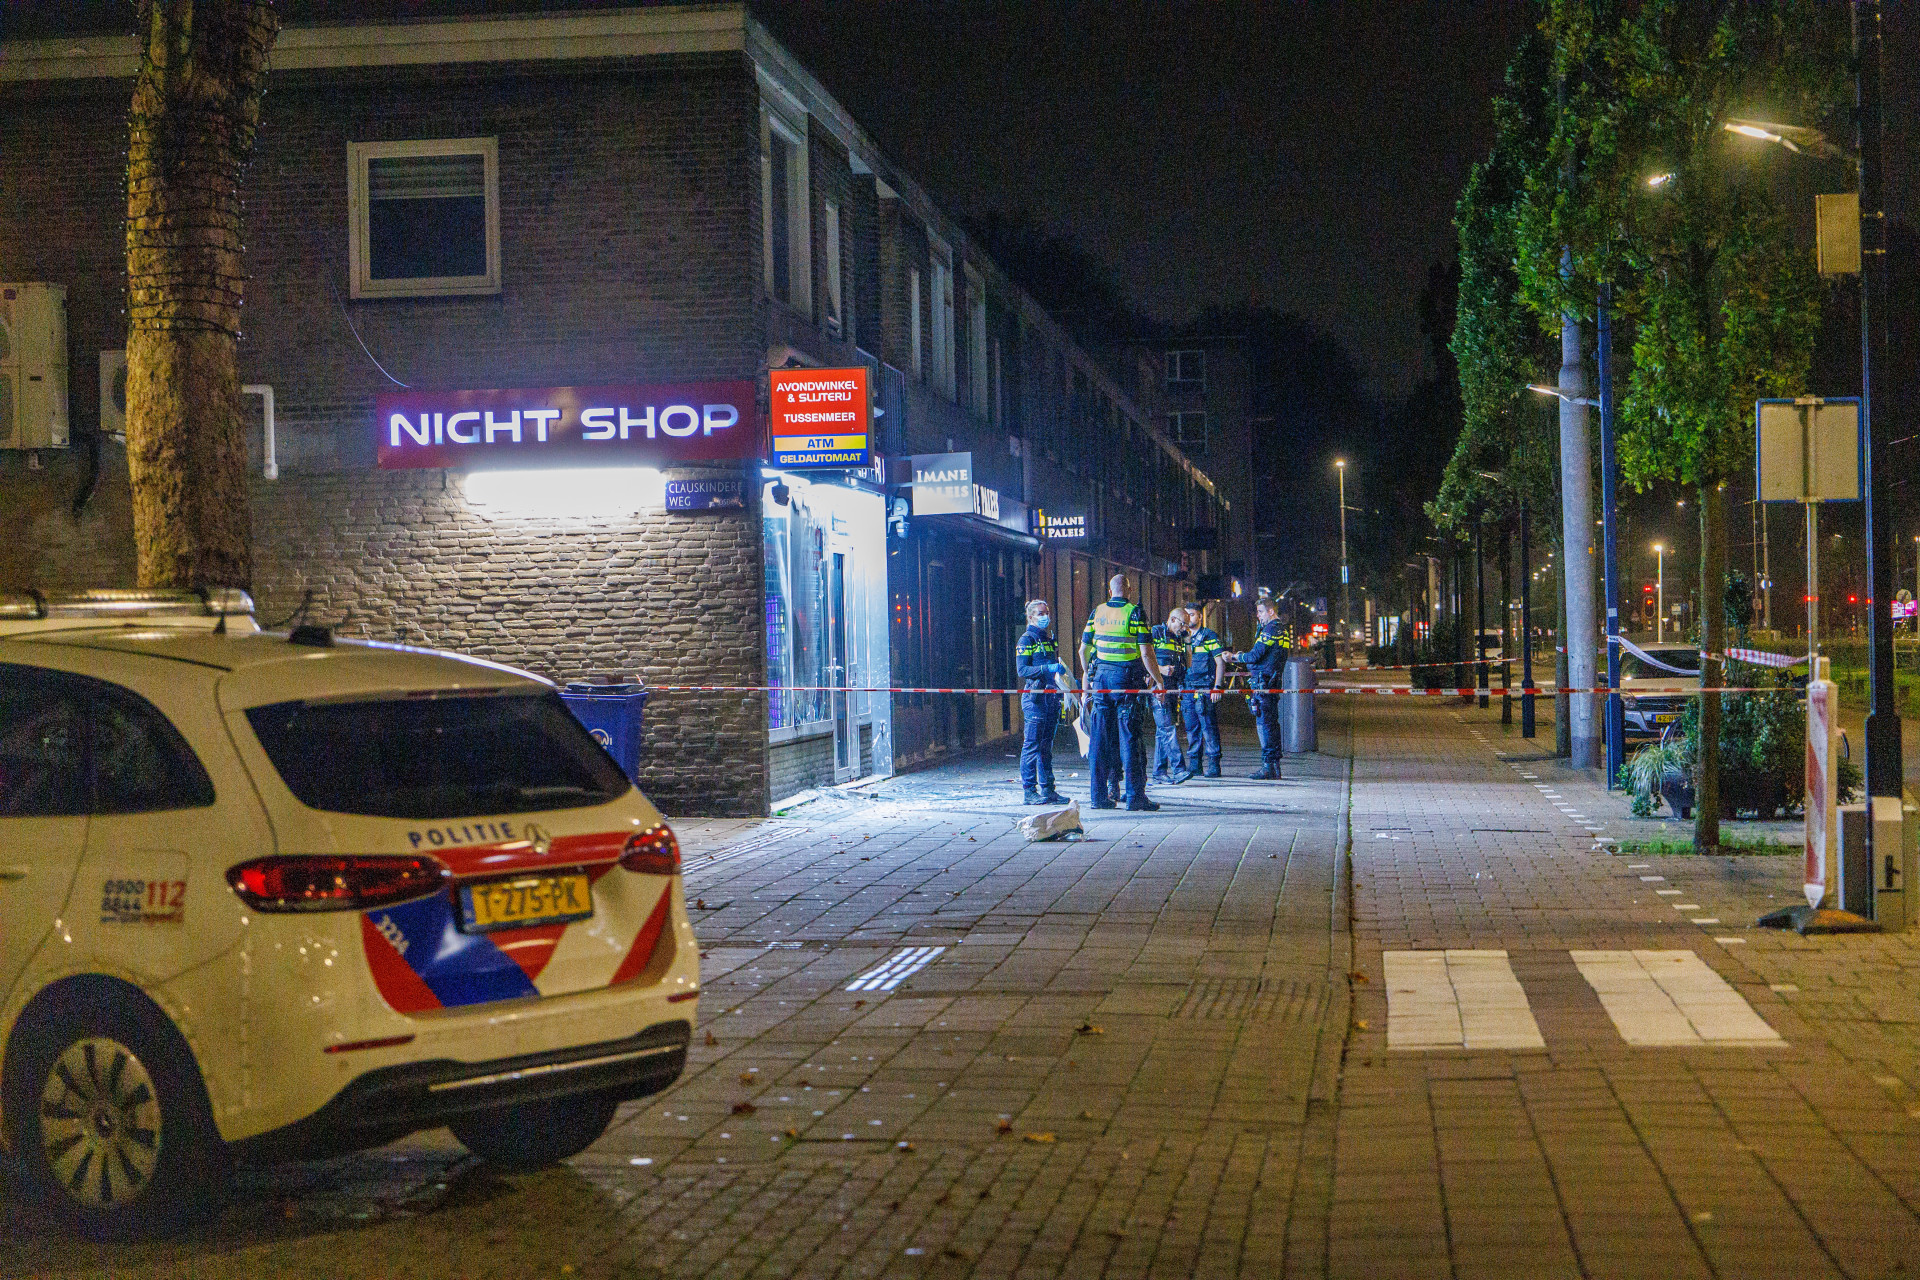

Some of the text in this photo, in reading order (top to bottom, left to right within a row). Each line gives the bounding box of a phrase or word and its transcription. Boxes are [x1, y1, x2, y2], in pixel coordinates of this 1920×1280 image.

[776, 381, 858, 392] AVONDWINKEL
[787, 392, 852, 403] & SLIJTERIJ
[783, 412, 856, 423] TUSSENMEER
[390, 403, 739, 447] NIGHT SHOP
[807, 438, 834, 449] ATM
[780, 453, 862, 464] GELDAUTOMAAT
[916, 469, 968, 483] IMANE
[668, 496, 691, 507] WEG
[1046, 516, 1085, 527] IMANE
[1047, 527, 1085, 538] PALEIS
[407, 822, 516, 849] POLITIE
[146, 881, 187, 908] 112
